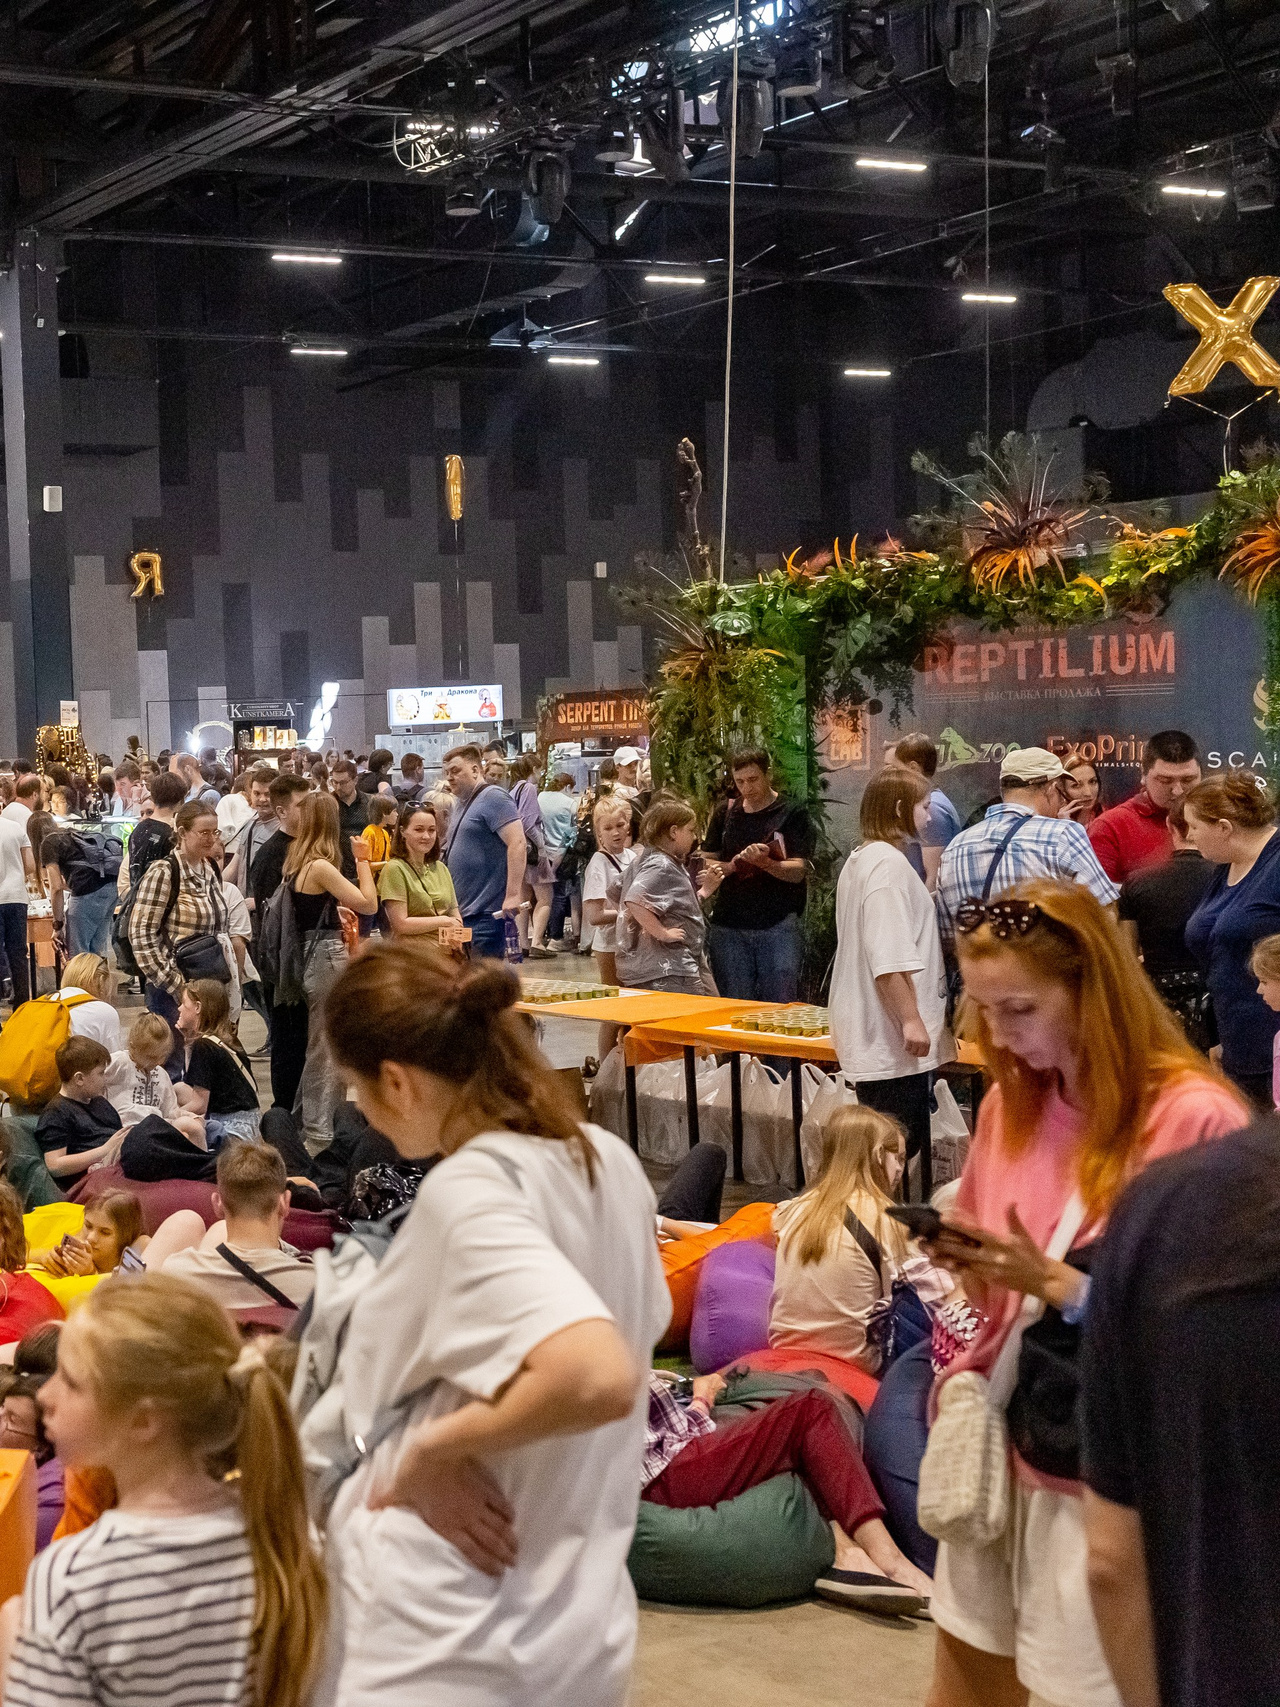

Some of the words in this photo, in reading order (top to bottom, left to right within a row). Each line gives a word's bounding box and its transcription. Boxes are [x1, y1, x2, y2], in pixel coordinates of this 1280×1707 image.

[923, 631, 1176, 685] REPTILIUM
[230, 703, 295, 718] KUNSTKAMERA
[557, 701, 617, 724] SERPENT
[621, 699, 649, 720] TIM
